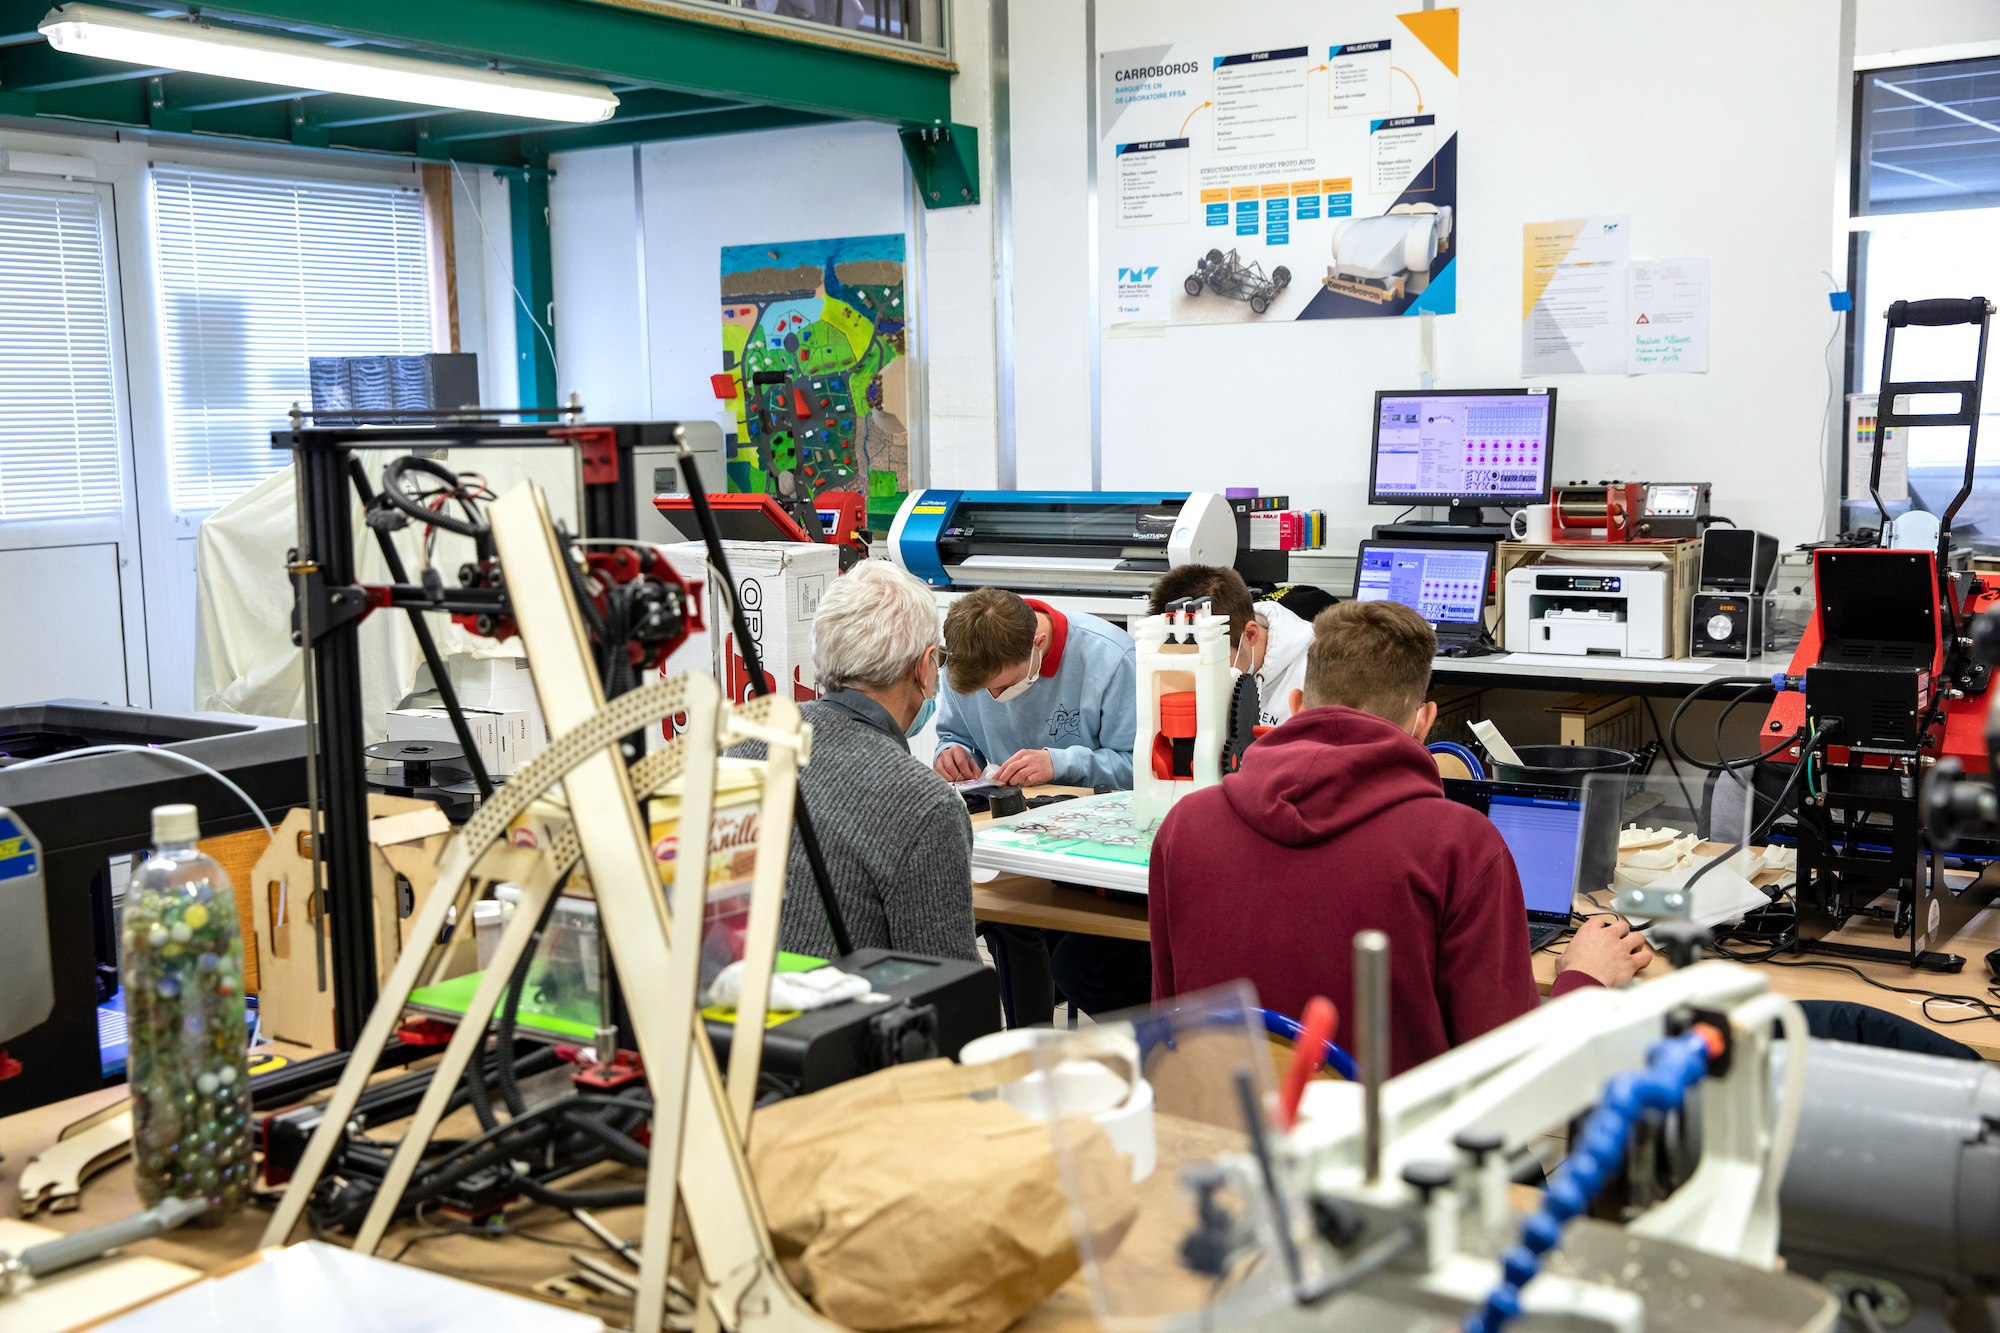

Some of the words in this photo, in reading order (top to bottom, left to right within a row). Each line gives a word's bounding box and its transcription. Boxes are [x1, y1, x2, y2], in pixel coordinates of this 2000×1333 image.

[1346, 42, 1379, 52] VALIDATION
[1115, 61, 1199, 82] CARROBOROS
[1115, 84, 1151, 95] BARQUETTE
[1115, 97, 1124, 105] DE
[1125, 92, 1168, 104] LABORATOIRE
[1169, 90, 1187, 99] FFSA
[1200, 164, 1248, 174] STRUCTURATION
[1277, 160, 1298, 168] PROTO
[1298, 158, 1316, 166] AUTO
[1327, 280, 1381, 300] Carroboros
